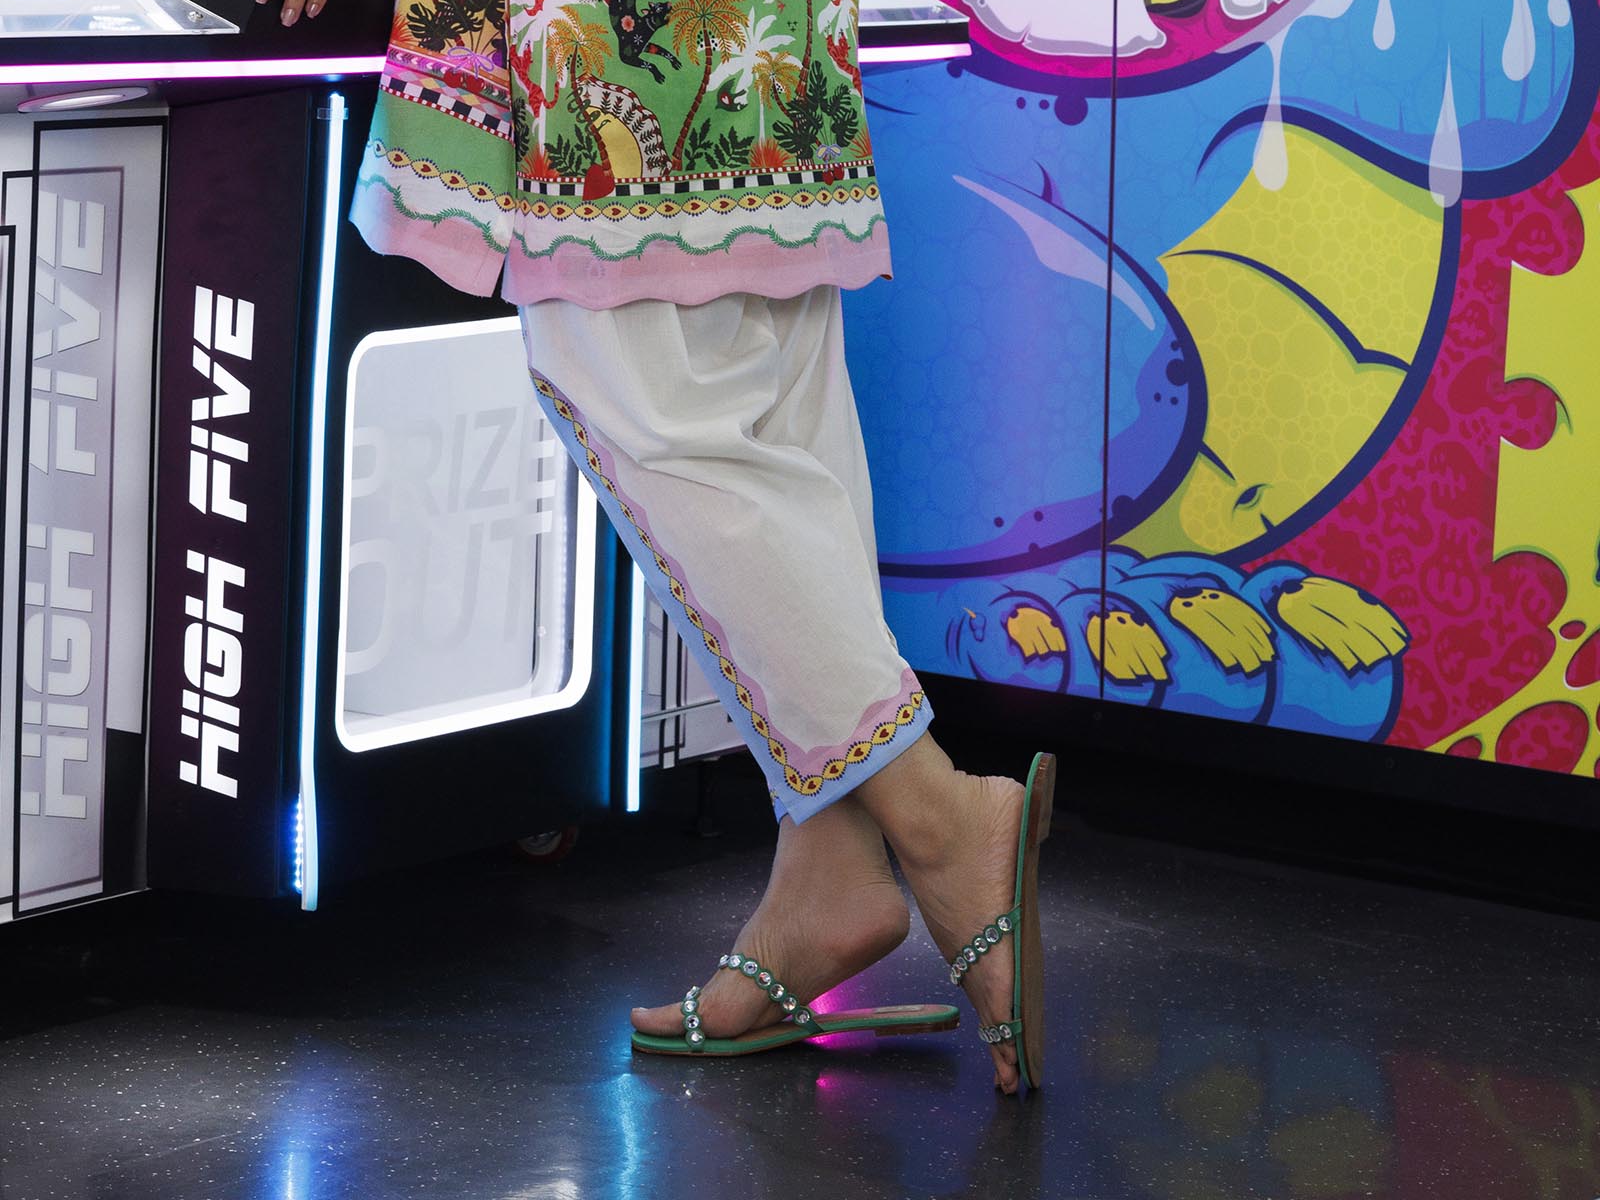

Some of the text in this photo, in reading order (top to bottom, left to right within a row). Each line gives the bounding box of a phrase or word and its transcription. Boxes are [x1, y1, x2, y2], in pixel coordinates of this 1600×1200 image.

[20, 190, 105, 819] HIGH FIVE
[179, 285, 255, 799] HIGH FIVE
